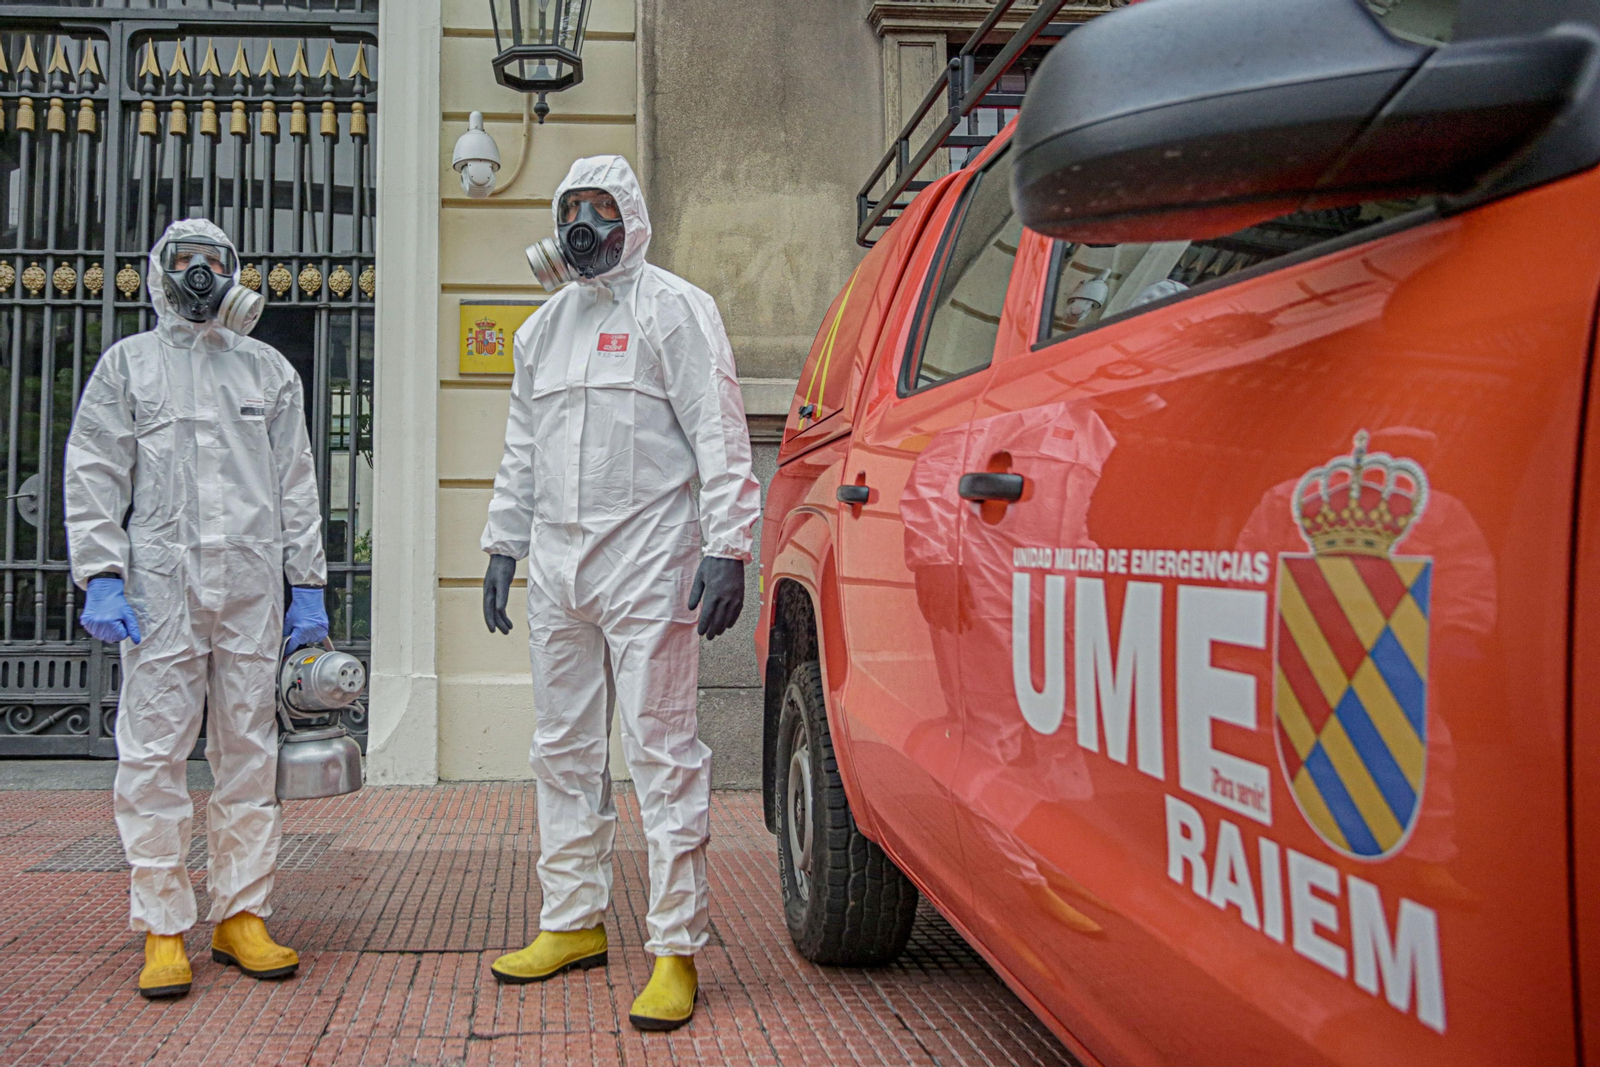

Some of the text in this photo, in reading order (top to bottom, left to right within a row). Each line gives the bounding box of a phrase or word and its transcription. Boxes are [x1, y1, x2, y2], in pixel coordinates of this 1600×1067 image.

[1013, 547, 1269, 582] UNIDAD MILITAR DE EMERGENCIAS
[1012, 572, 1271, 825] UME
[1164, 793, 1446, 1034] RAIEM
